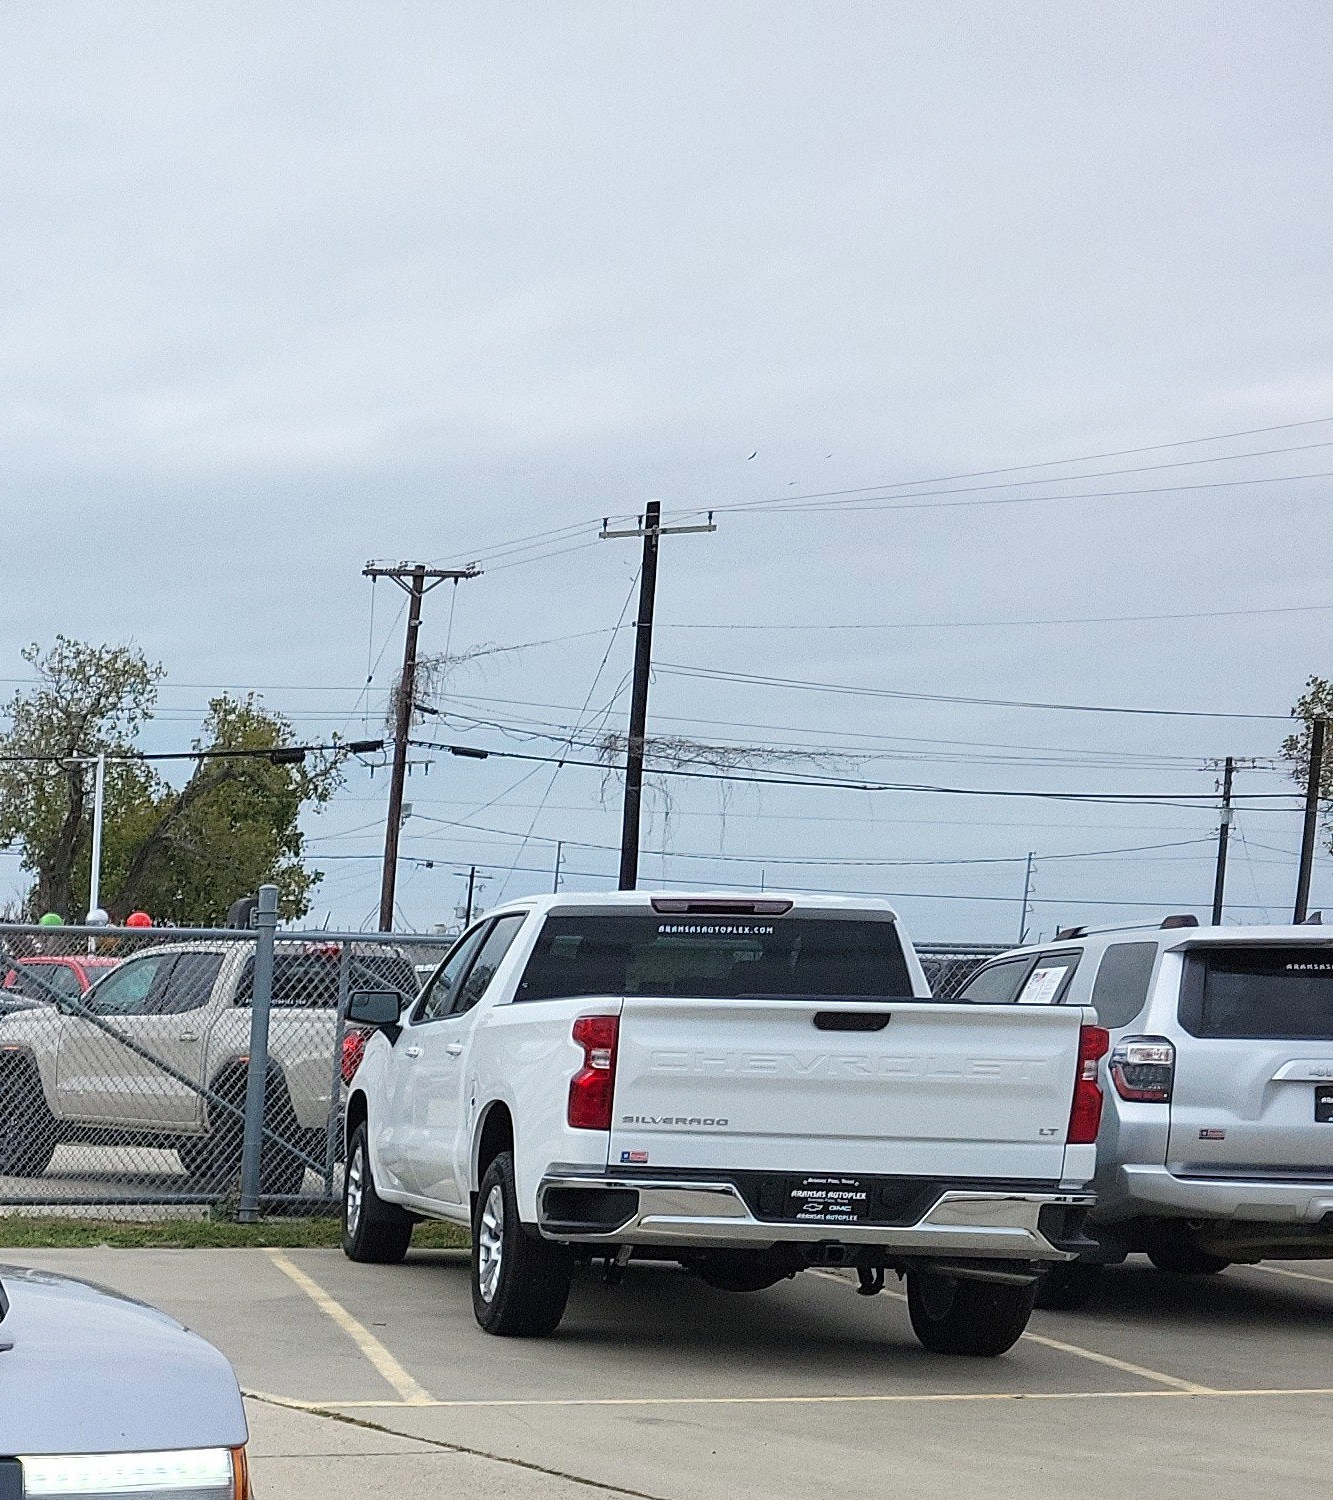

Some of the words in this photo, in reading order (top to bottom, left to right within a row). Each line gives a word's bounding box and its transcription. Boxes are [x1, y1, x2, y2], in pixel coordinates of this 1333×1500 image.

[651, 1050, 1047, 1079] CHEVROLET
[622, 1116, 729, 1126] SILVERADO
[1039, 1128, 1059, 1136] LT
